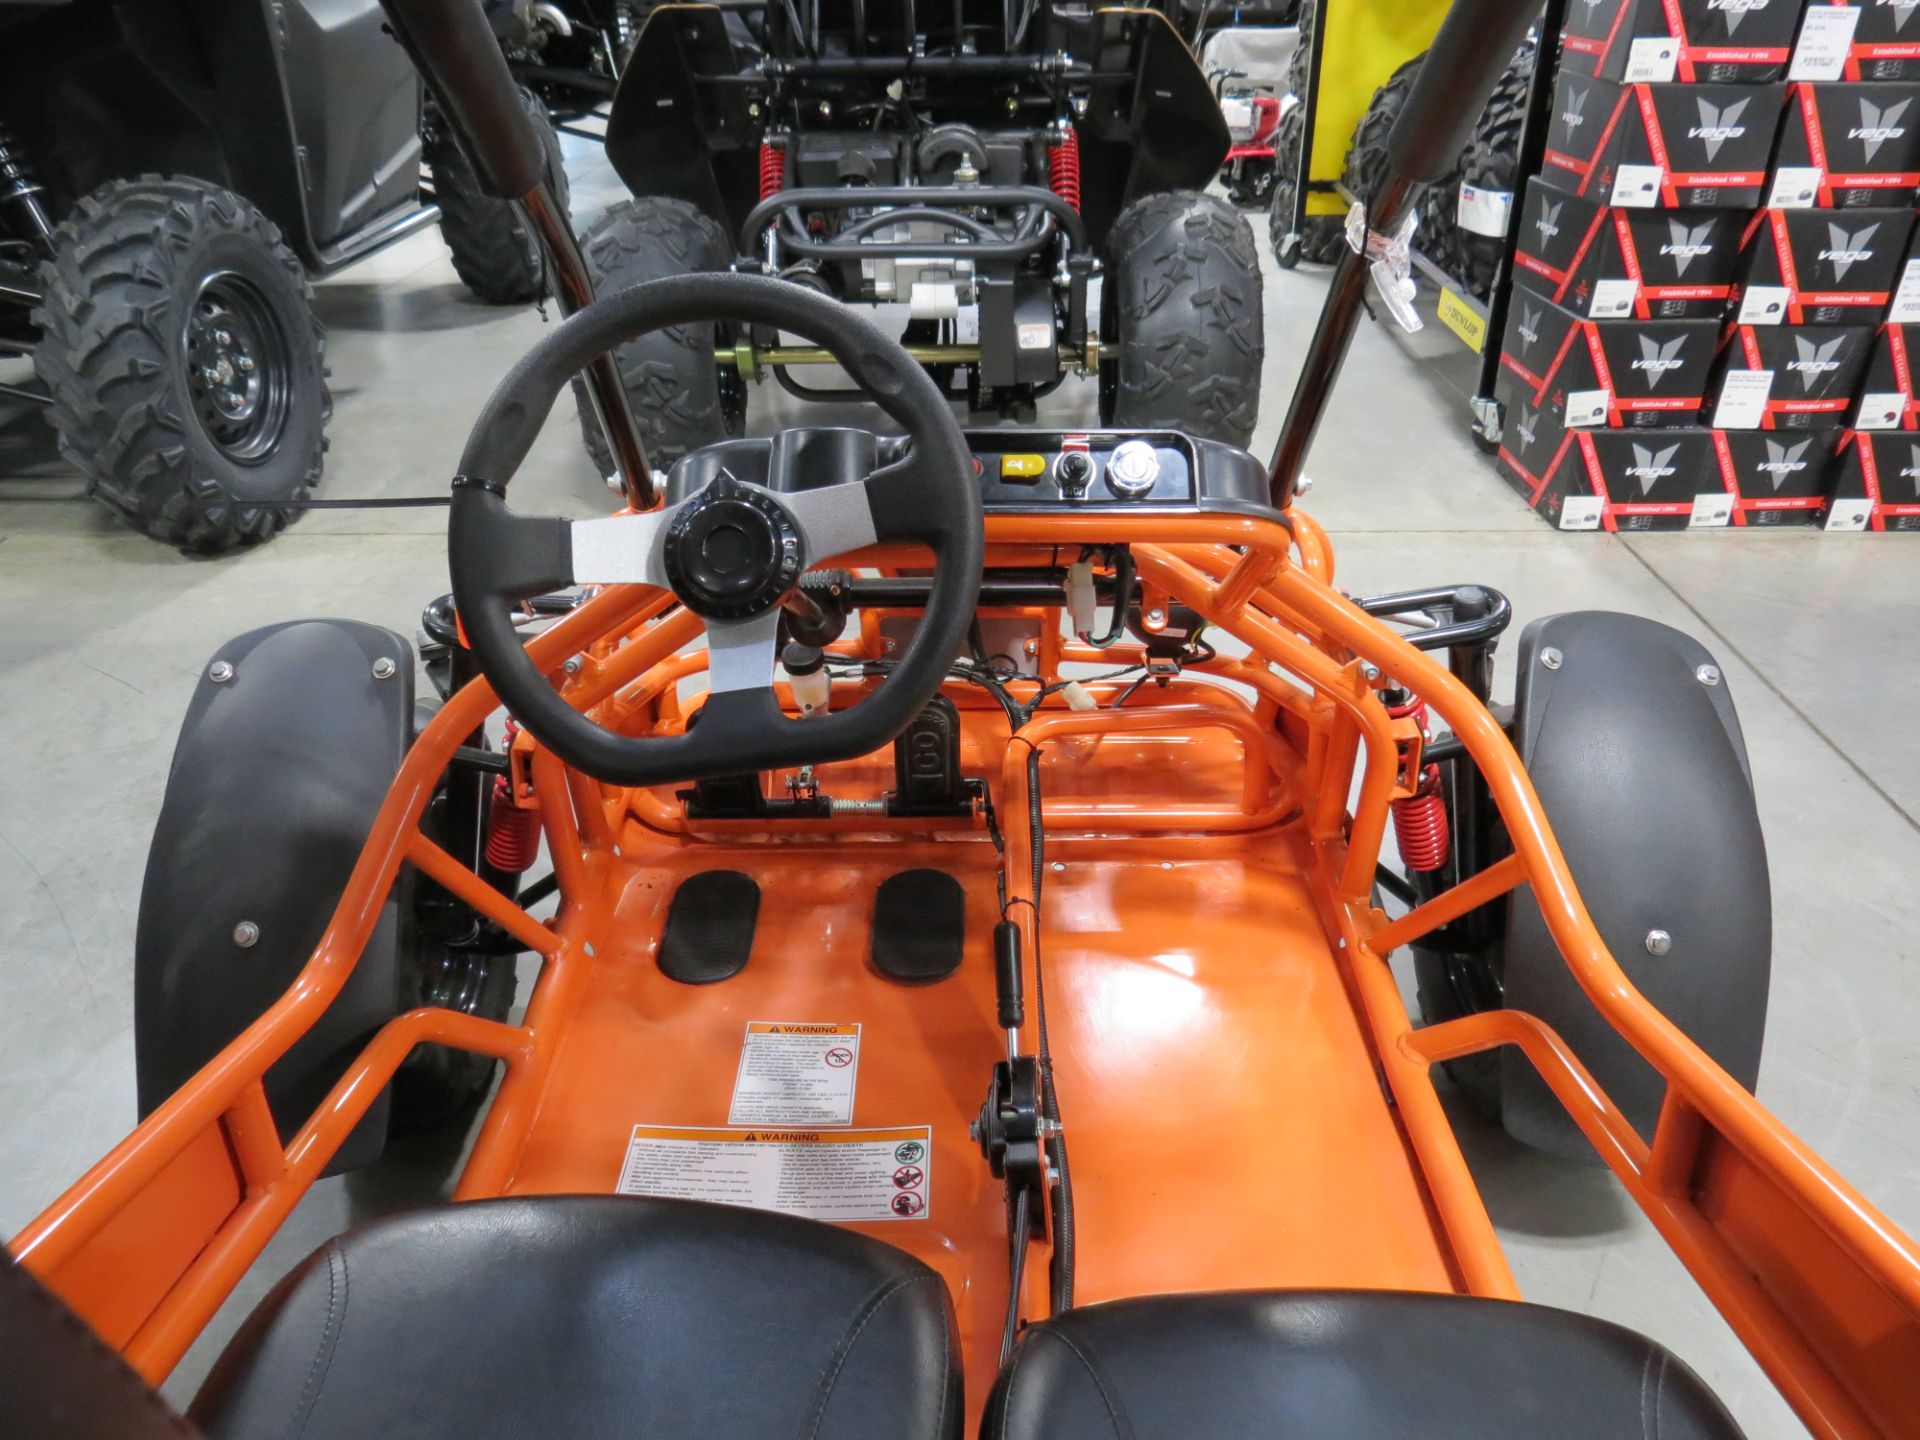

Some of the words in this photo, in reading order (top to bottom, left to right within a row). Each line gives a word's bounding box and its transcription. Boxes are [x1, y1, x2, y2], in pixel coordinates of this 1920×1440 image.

[1688, 127, 1745, 141] vega
[1848, 127, 1905, 141] vega
[1660, 244, 1712, 258] vega
[1818, 250, 1873, 263] vega
[1450, 306, 1479, 336] DUNLOP
[1631, 359, 1684, 372] vega
[1786, 361, 1840, 373] vega
[1625, 467, 1676, 479] vega
[1757, 462, 1807, 473] vega
[783, 1026, 838, 1034] WARNING
[761, 1132, 820, 1142] WARNING
